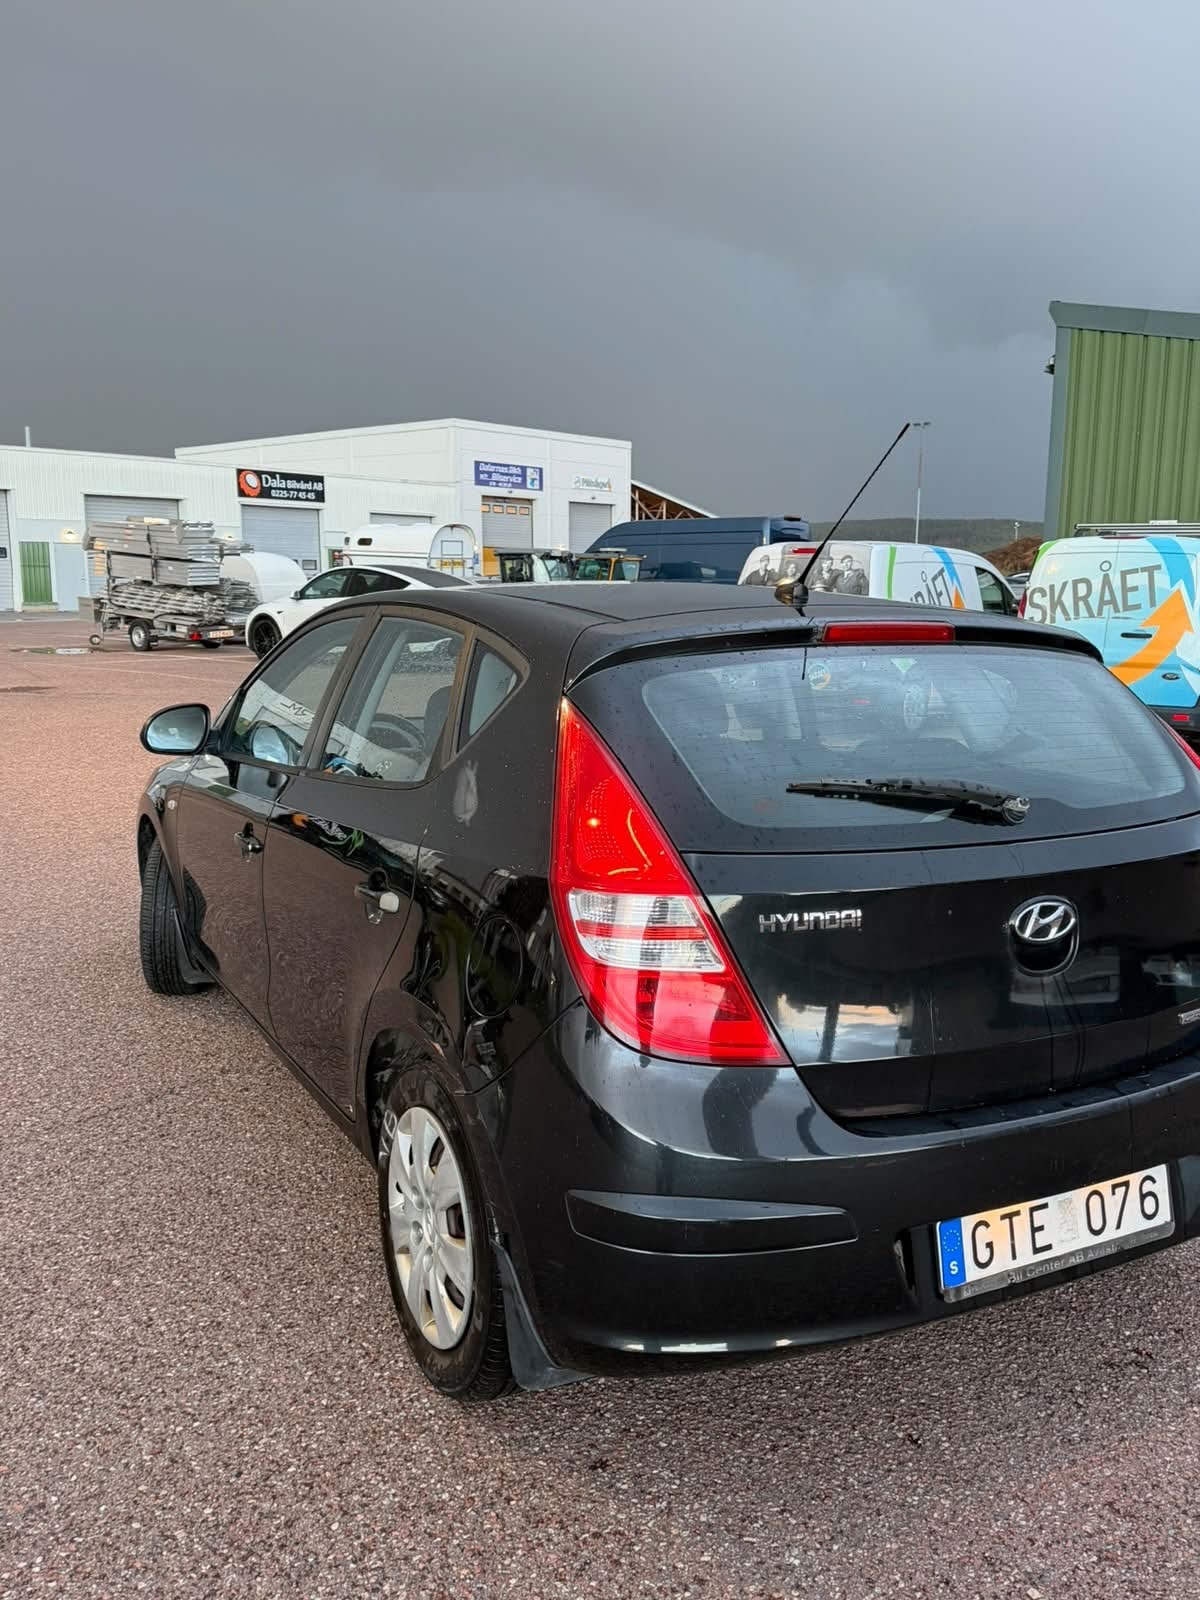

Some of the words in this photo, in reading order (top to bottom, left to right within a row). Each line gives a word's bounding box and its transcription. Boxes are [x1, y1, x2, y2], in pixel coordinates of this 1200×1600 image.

[261, 474, 286, 489] Dala
[313, 481, 324, 491] AB
[1027, 560, 1162, 625] SKRÅET
[759, 909, 862, 933] HYUNDAI
[971, 1203, 1053, 1270] GTE
[1085, 1174, 1160, 1237] 076
[949, 1260, 959, 1275] S
[1026, 1259, 1065, 1277] Center
